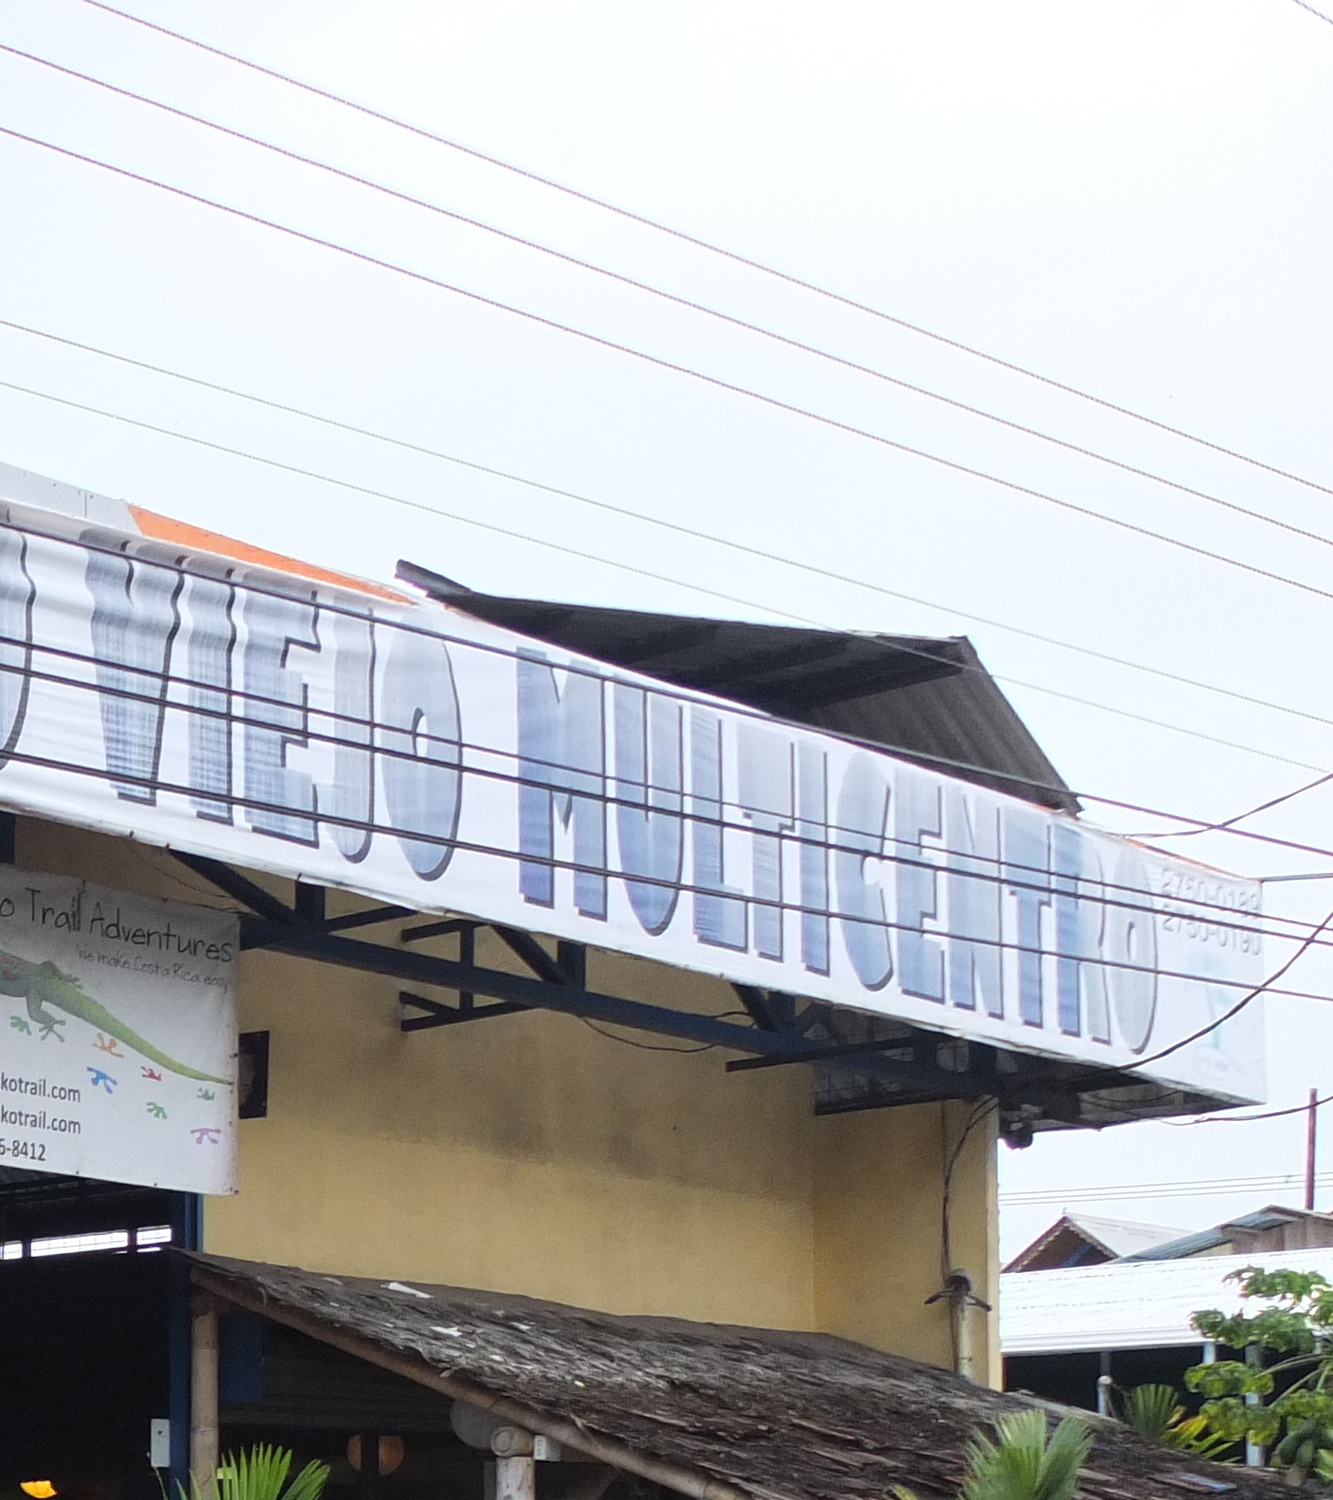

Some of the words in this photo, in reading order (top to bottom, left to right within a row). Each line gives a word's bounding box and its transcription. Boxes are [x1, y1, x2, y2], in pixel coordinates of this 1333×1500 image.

[24, 886, 82, 932] Trail
[89, 903, 234, 964] Adventures
[79, 530, 463, 881] VIEJO
[516, 645, 1159, 1055] MULTICENTRO
